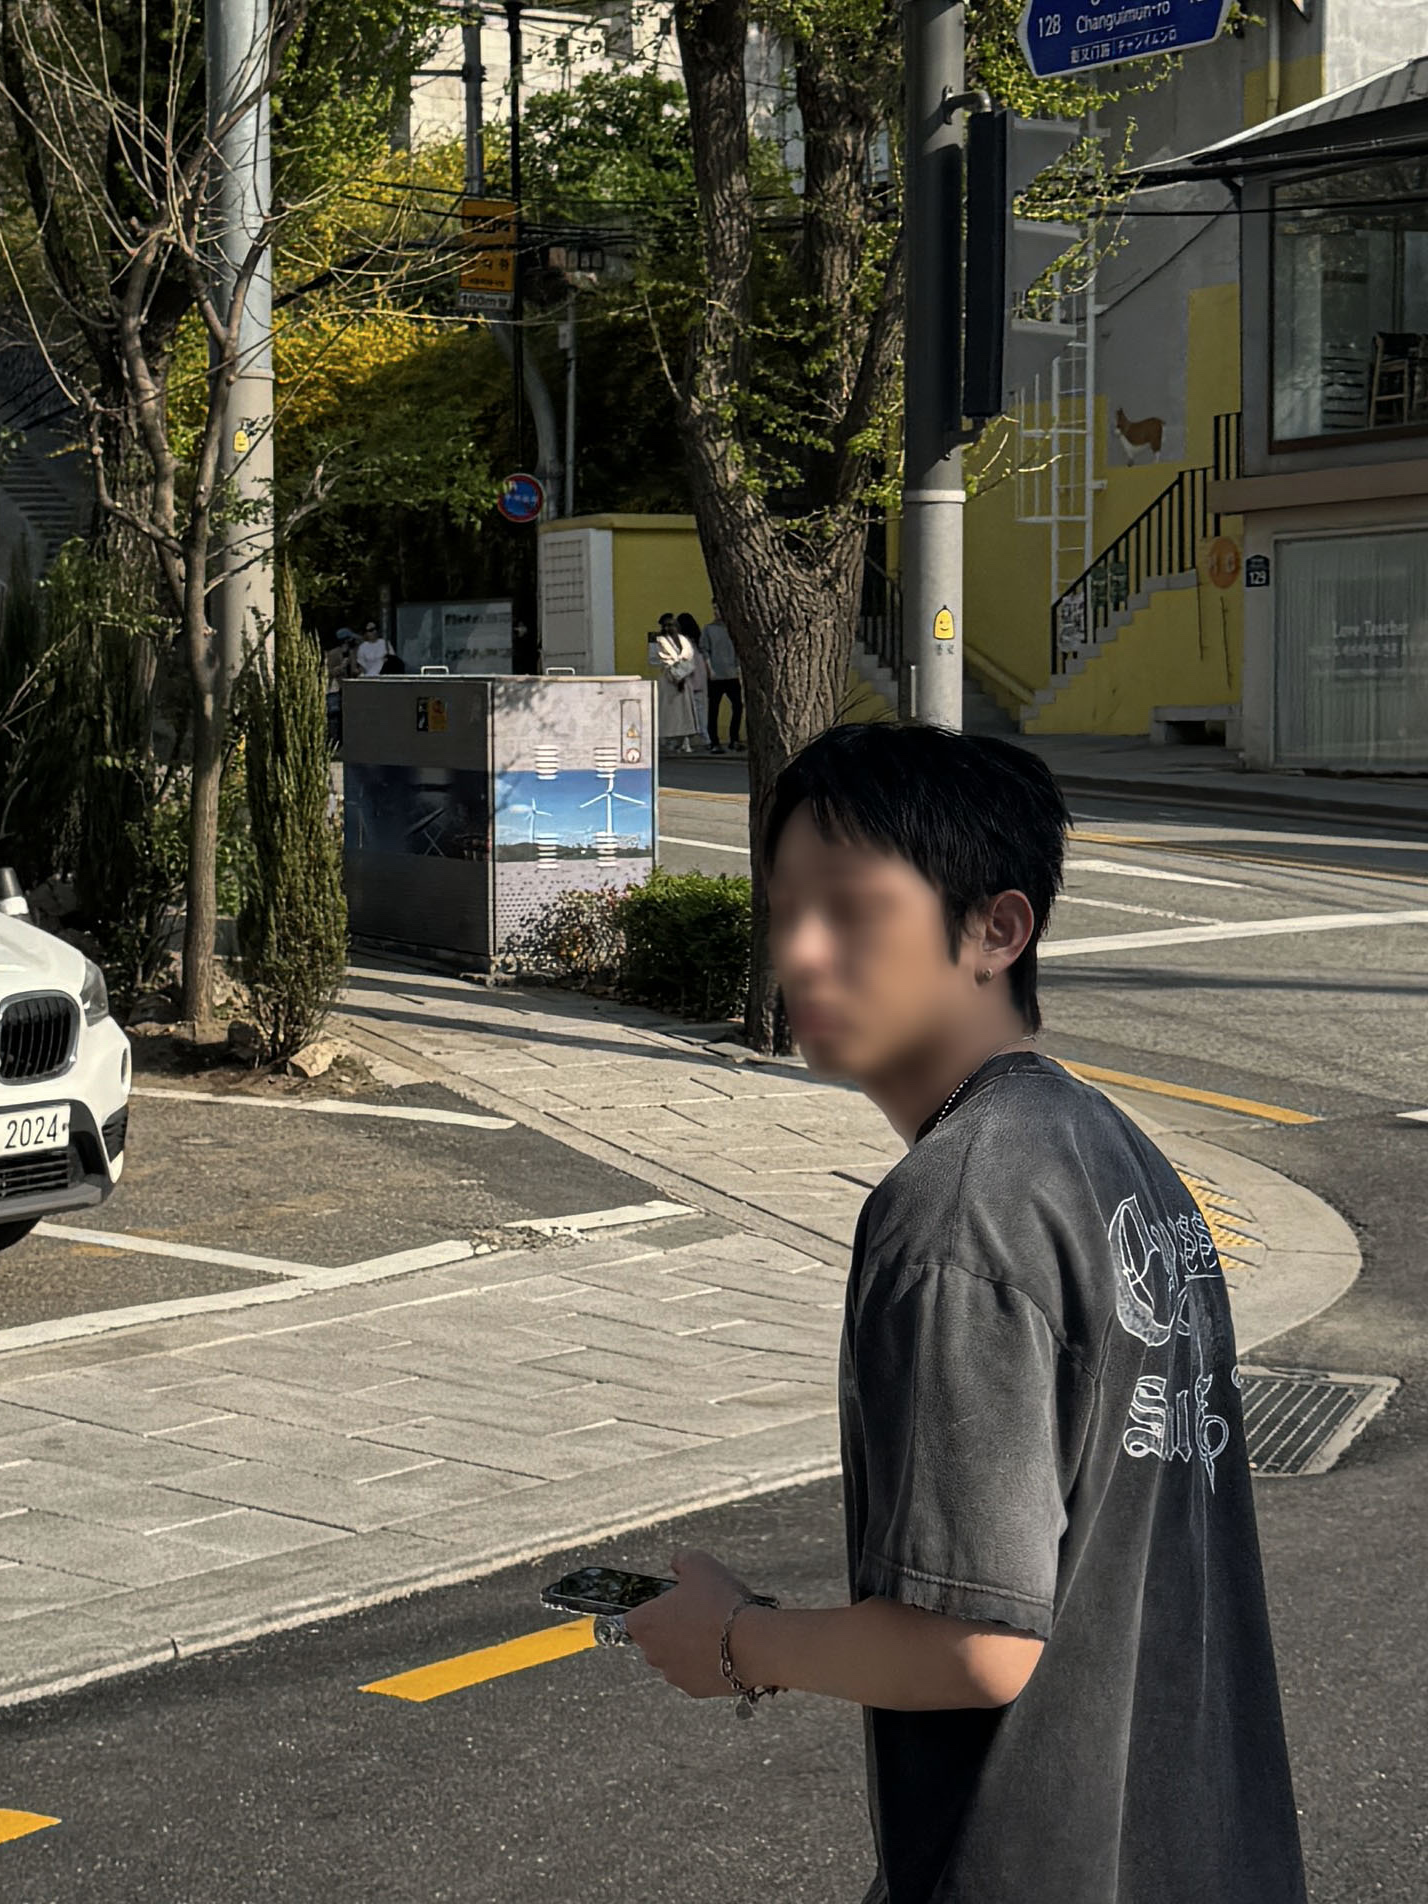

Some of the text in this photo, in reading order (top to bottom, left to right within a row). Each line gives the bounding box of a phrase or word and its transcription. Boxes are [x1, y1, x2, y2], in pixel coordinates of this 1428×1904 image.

[1038, 14, 1062, 38] 128
[1076, 0, 1170, 34] Changuimun-ro
[4, 1113, 58, 1150] 2024
